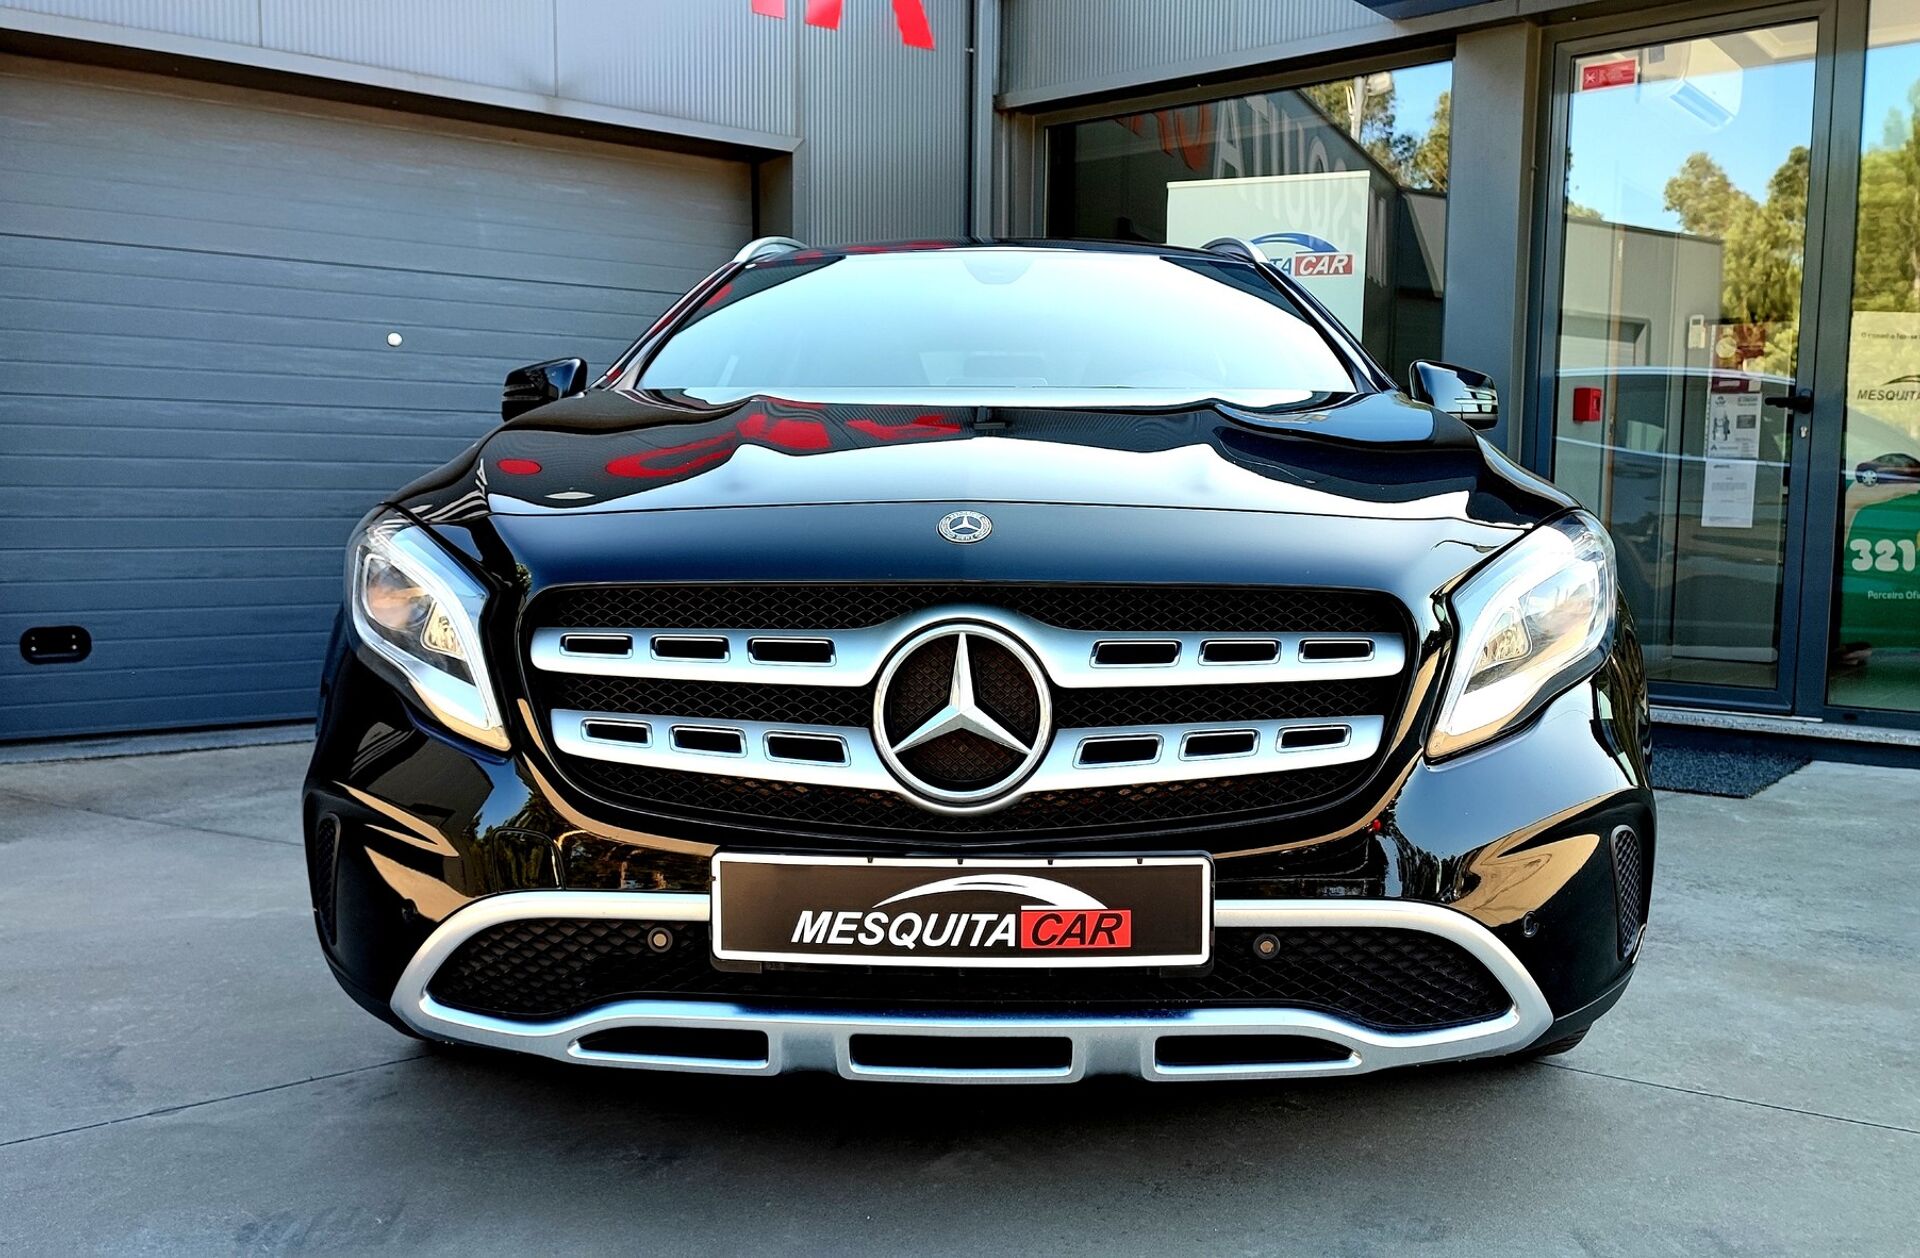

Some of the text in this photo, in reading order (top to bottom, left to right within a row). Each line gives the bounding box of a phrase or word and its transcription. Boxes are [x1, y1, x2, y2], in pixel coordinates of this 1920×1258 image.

[1299, 255, 1349, 276] CAR
[1849, 538, 1916, 572] 321
[790, 910, 1123, 950] MESQUITA CAR
